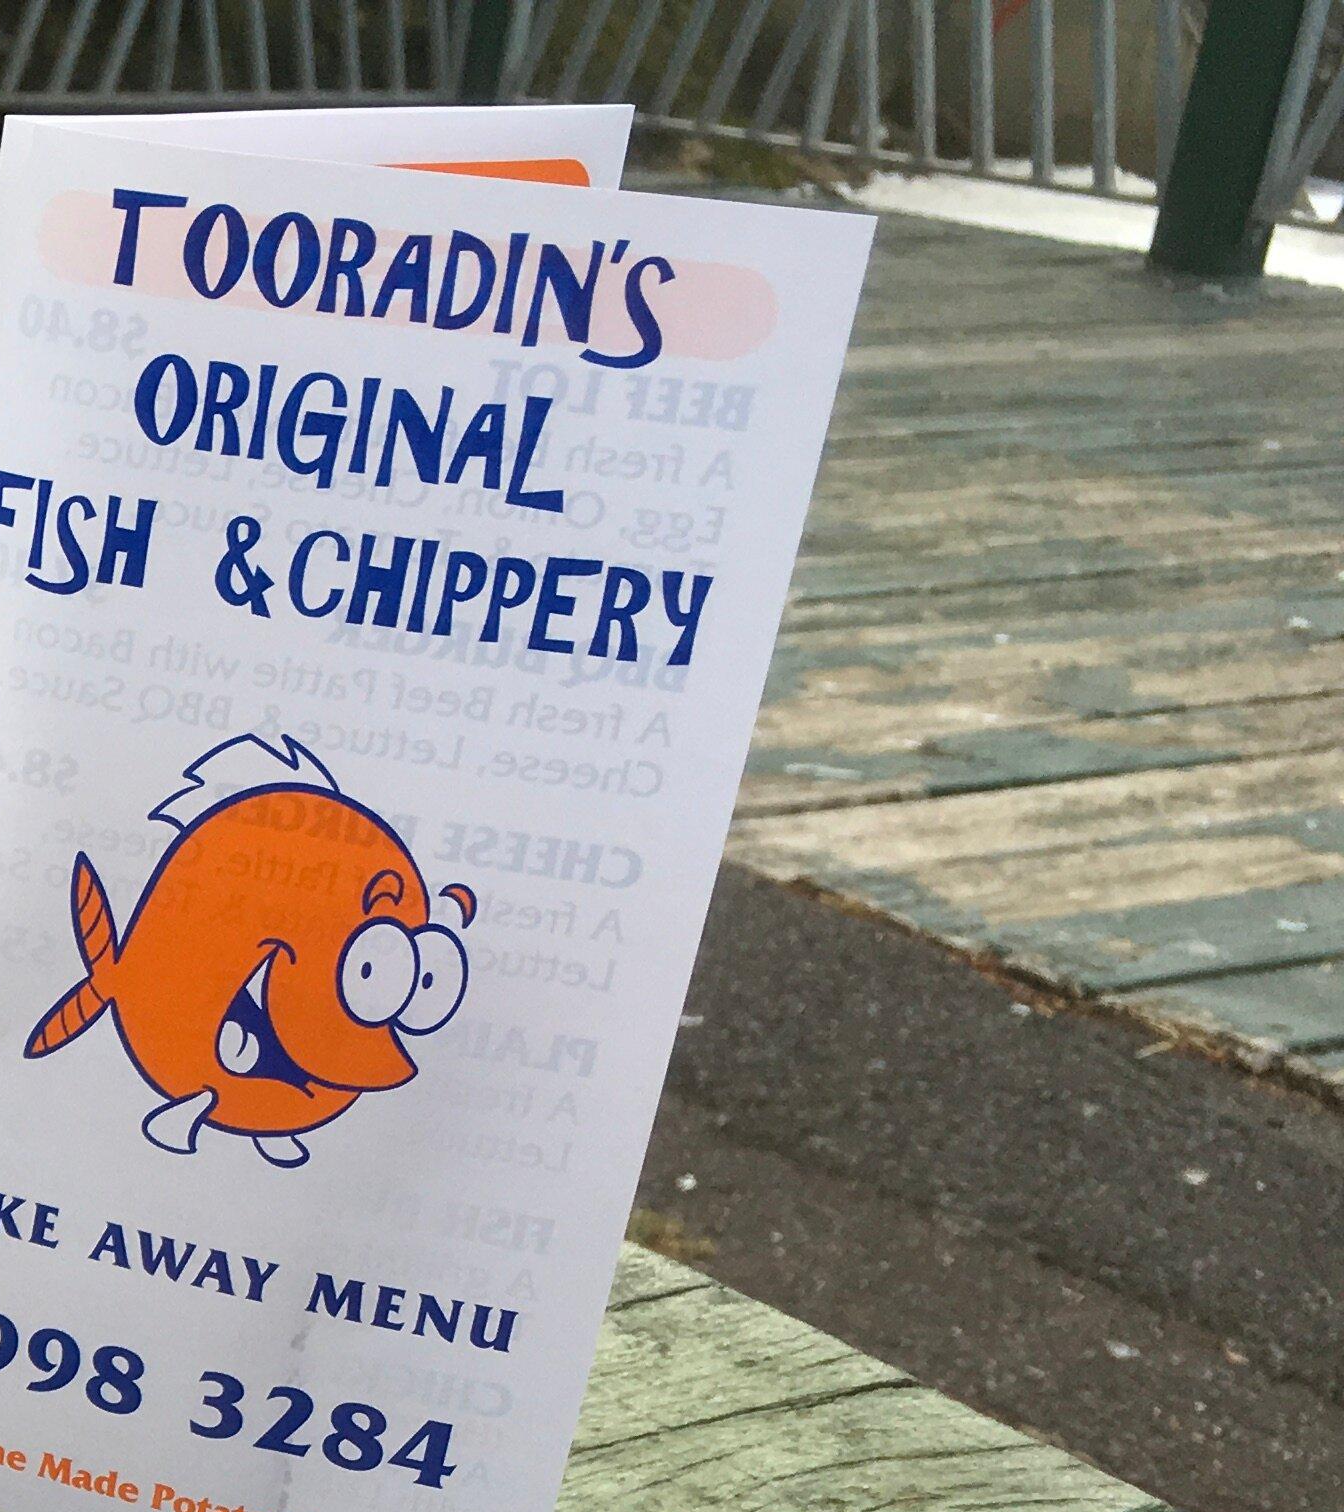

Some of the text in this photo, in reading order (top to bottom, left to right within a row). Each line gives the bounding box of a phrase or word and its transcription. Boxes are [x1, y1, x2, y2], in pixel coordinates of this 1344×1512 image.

[111, 187, 677, 371] TOORADIN'S
[132, 352, 565, 515] ORIGINAL
[88, 1220, 281, 1304] AWAY
[305, 1271, 520, 1354] MENU
[37, 1451, 140, 1503] Made
[188, 1369, 458, 1491] 3284
